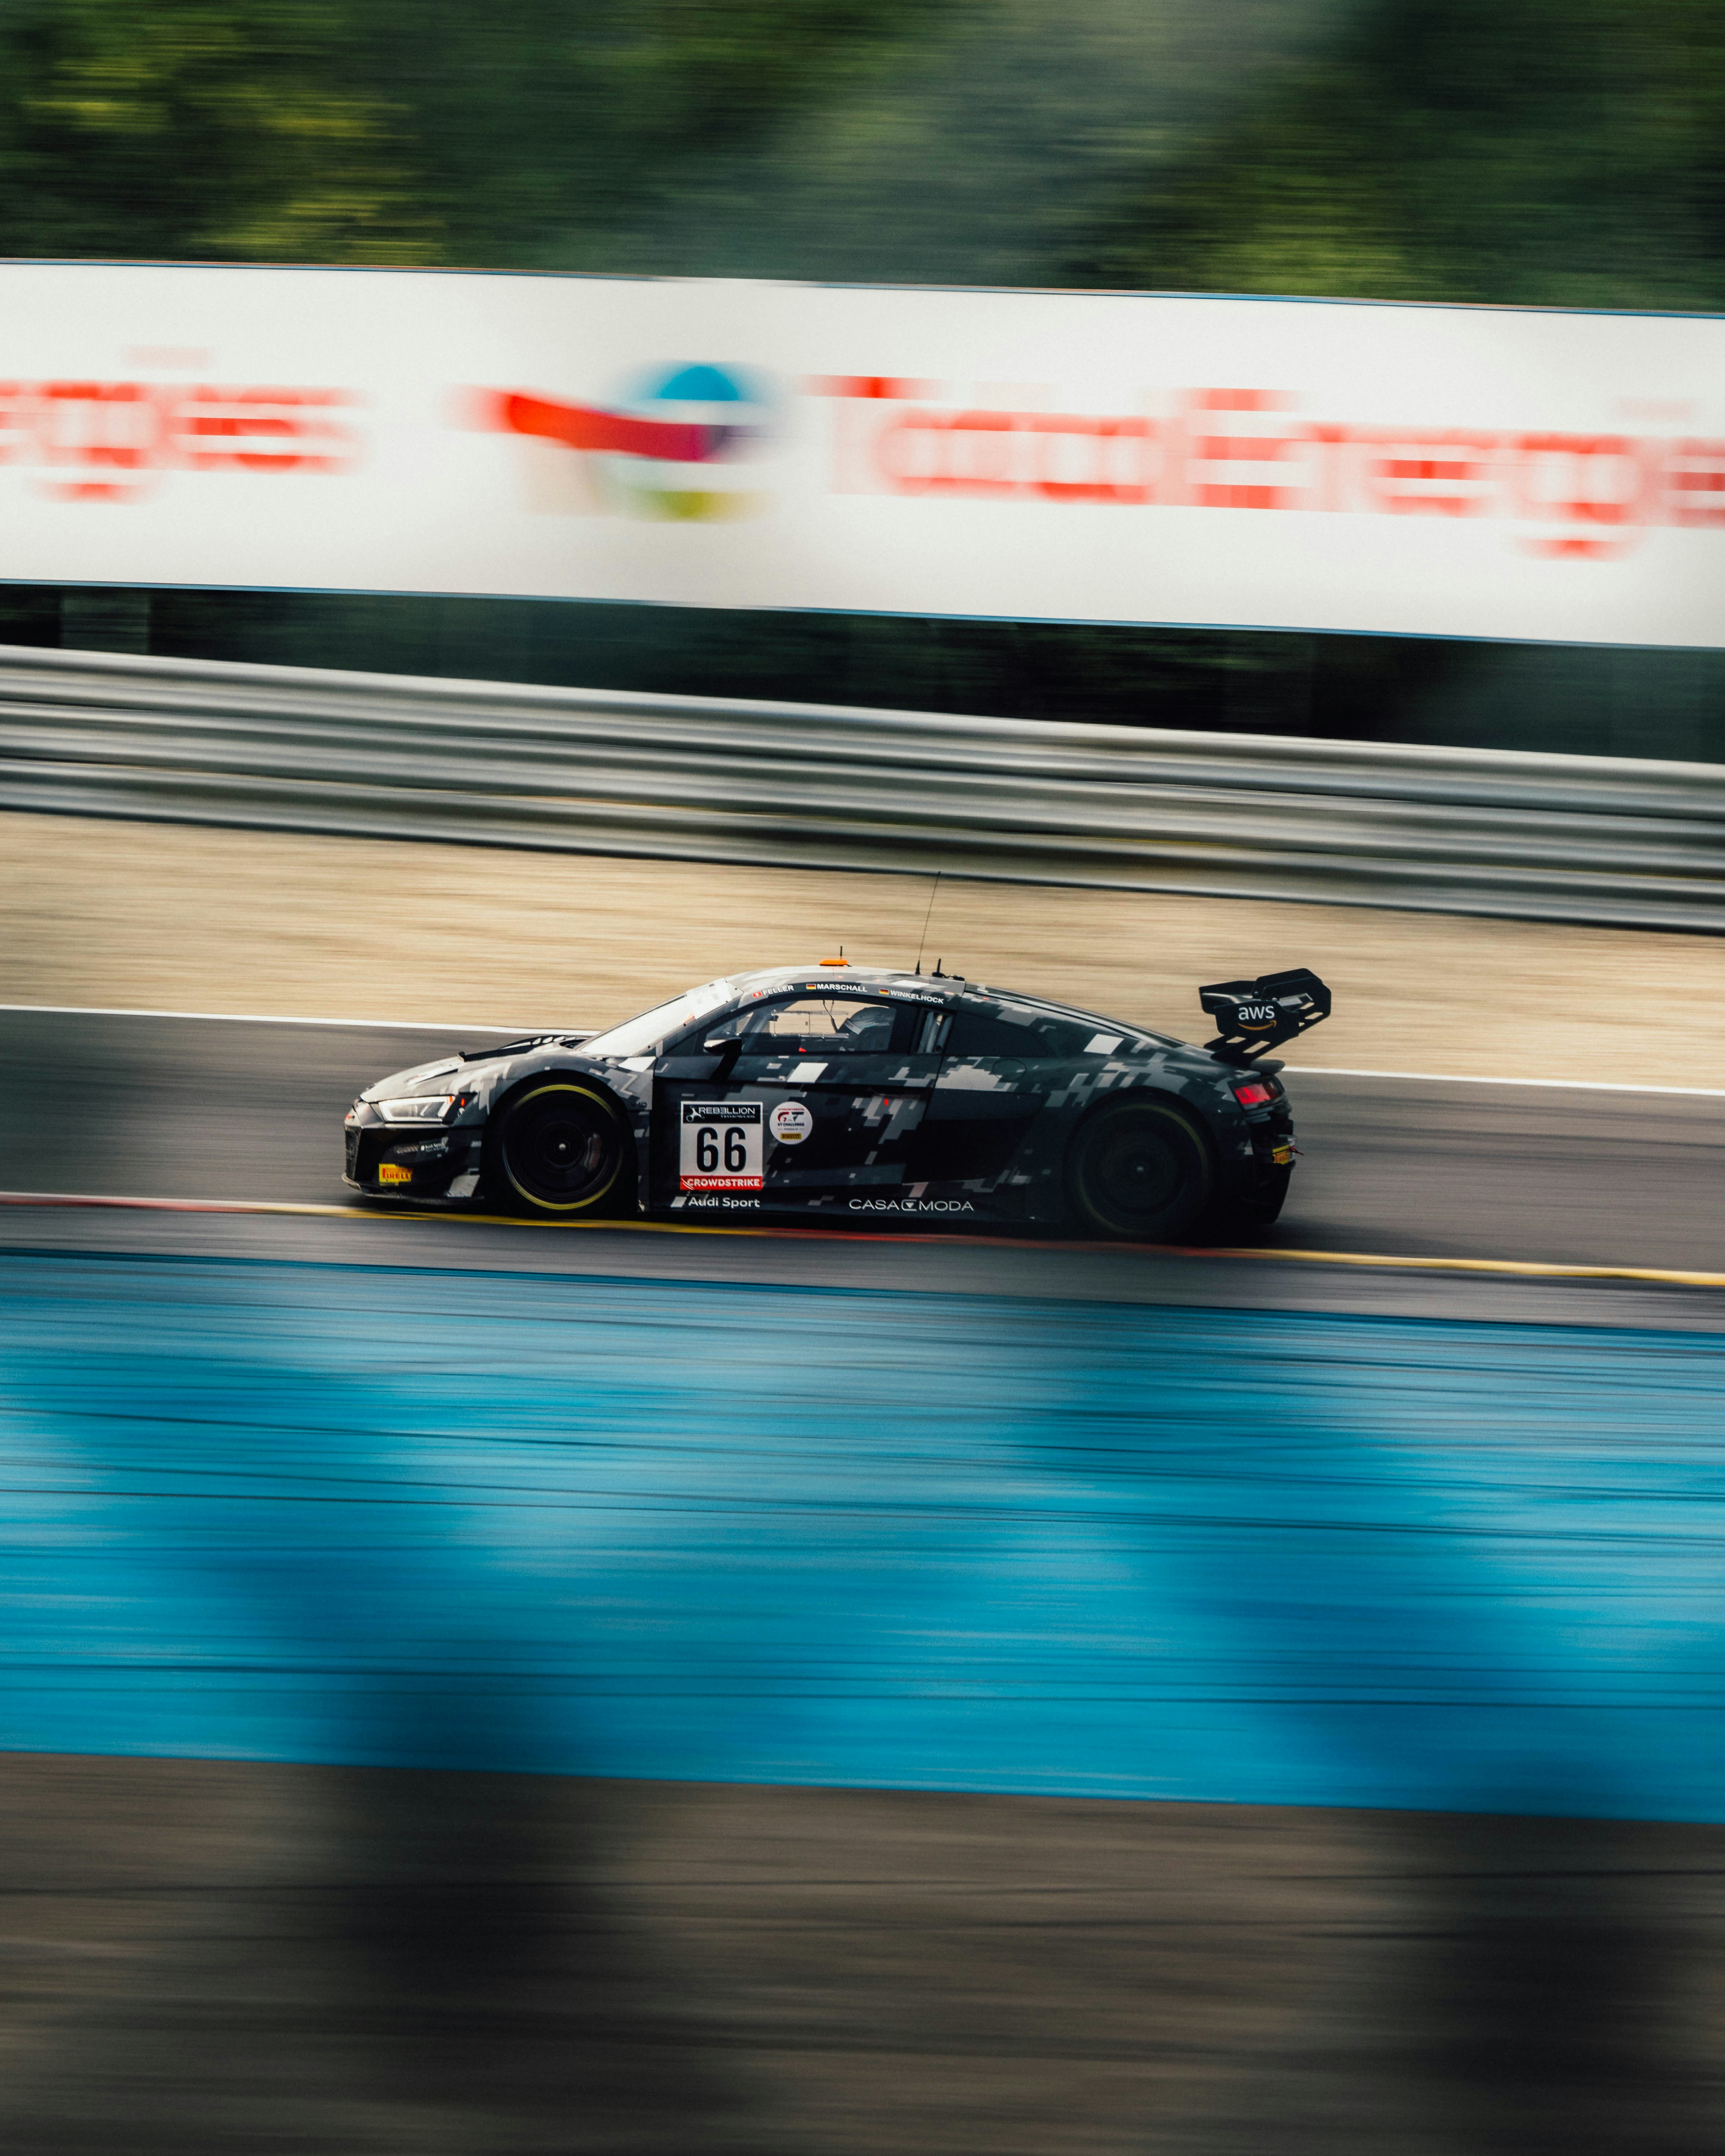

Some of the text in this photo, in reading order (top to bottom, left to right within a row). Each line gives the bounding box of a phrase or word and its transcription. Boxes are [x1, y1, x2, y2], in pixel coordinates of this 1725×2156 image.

[763, 985, 794, 996] FELLER
[817, 983, 868, 992] MARSCHALL
[890, 990, 944, 1004] WINKELHOCK
[1238, 1006, 1275, 1020] aws
[697, 1126, 747, 1173] 66
[687, 1178, 760, 1187] CROWDSTRIKE
[689, 1197, 760, 1209] Audi Sport
